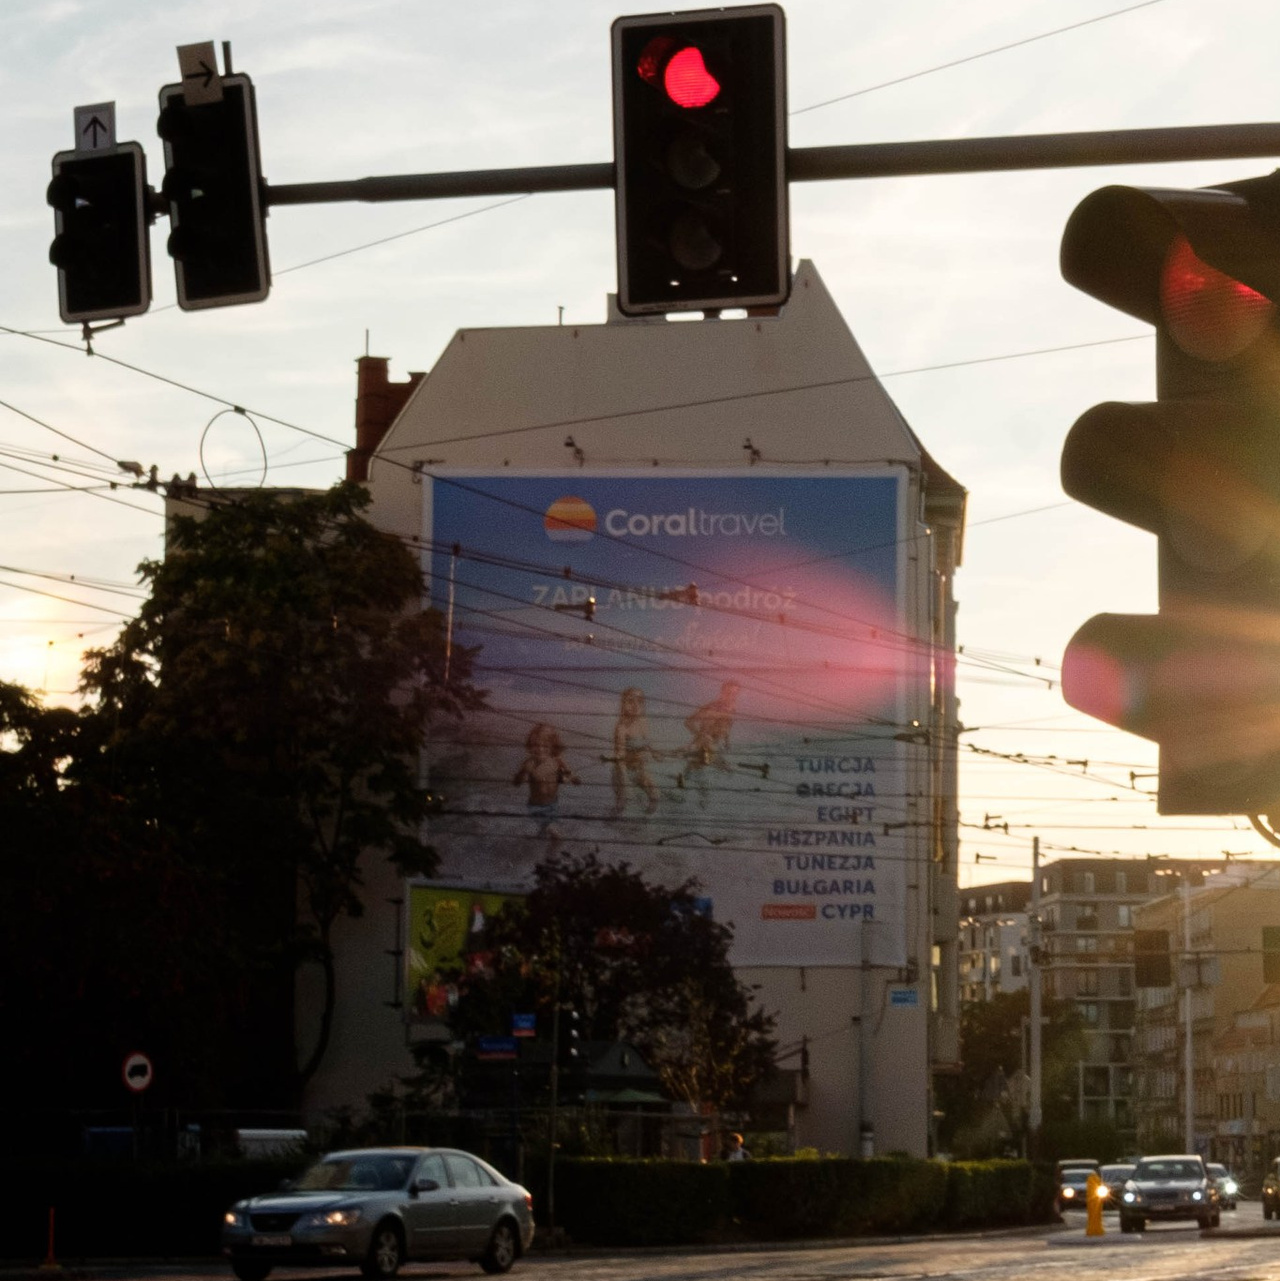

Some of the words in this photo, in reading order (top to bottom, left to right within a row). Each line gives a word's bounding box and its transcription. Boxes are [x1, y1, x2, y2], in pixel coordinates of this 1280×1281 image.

[796, 757, 876, 774] TURCJA
[817, 807, 876, 822] EGIPT
[767, 830, 876, 846] HISZPANIA
[784, 855, 876, 871] TUNEZJA
[773, 880, 876, 895] BUŁGARIA
[821, 904, 875, 919] CYPR
